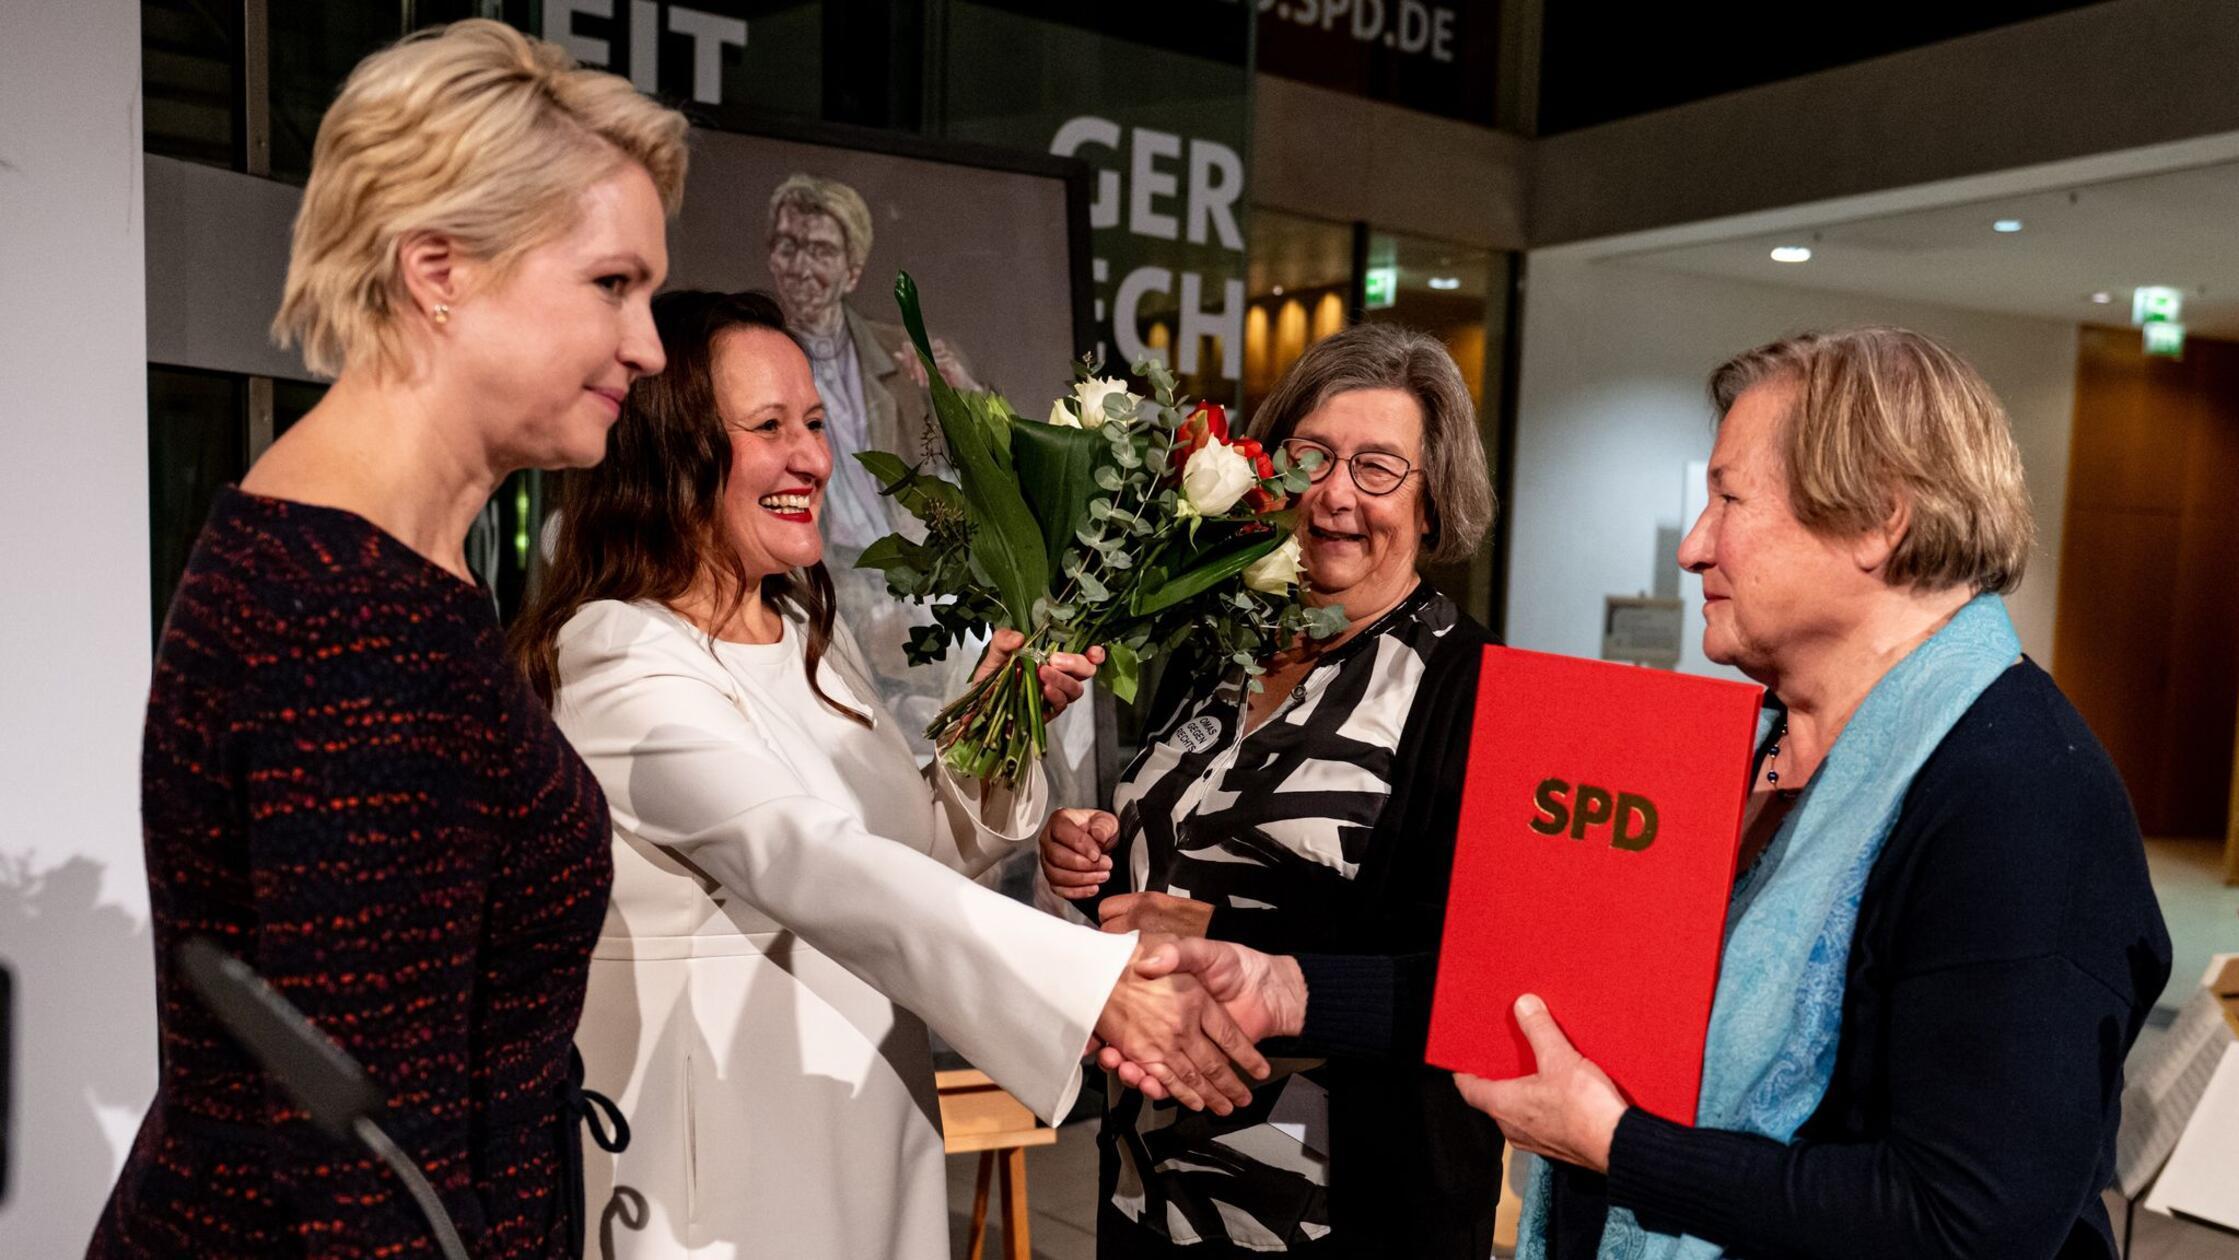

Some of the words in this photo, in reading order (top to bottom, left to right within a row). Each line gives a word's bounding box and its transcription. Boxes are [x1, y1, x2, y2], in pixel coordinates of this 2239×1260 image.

[1187, 722, 1207, 745] GEGEN
[1200, 717, 1217, 736] OMAS
[1176, 727, 1197, 753] RECHTS
[1528, 777, 1659, 853] SPD
